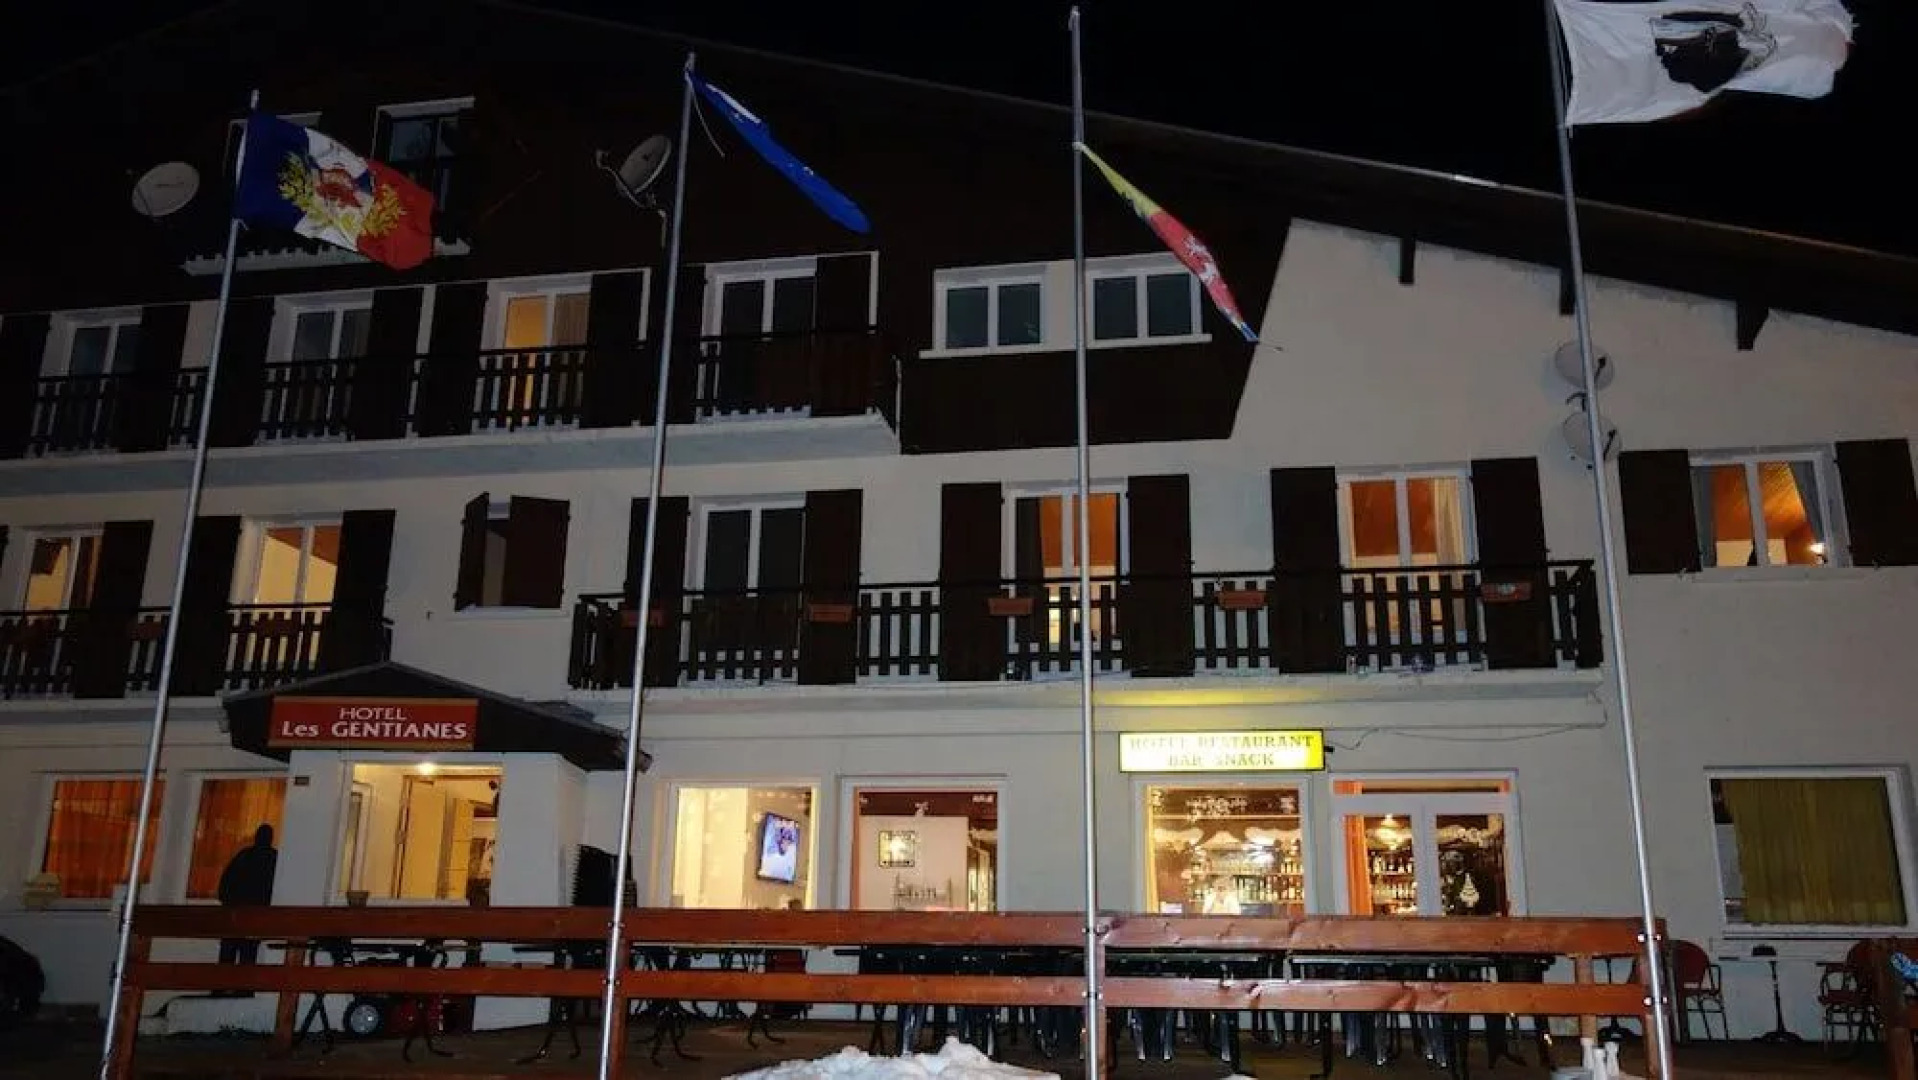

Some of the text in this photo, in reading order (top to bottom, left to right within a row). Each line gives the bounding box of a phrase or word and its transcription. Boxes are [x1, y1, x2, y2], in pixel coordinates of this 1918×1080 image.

[339, 707, 407, 721] HOTEL
[281, 720, 468, 740] Les GENTIANES
[1198, 734, 1315, 749] RESTAURANT
[1214, 752, 1275, 767] SNACK
